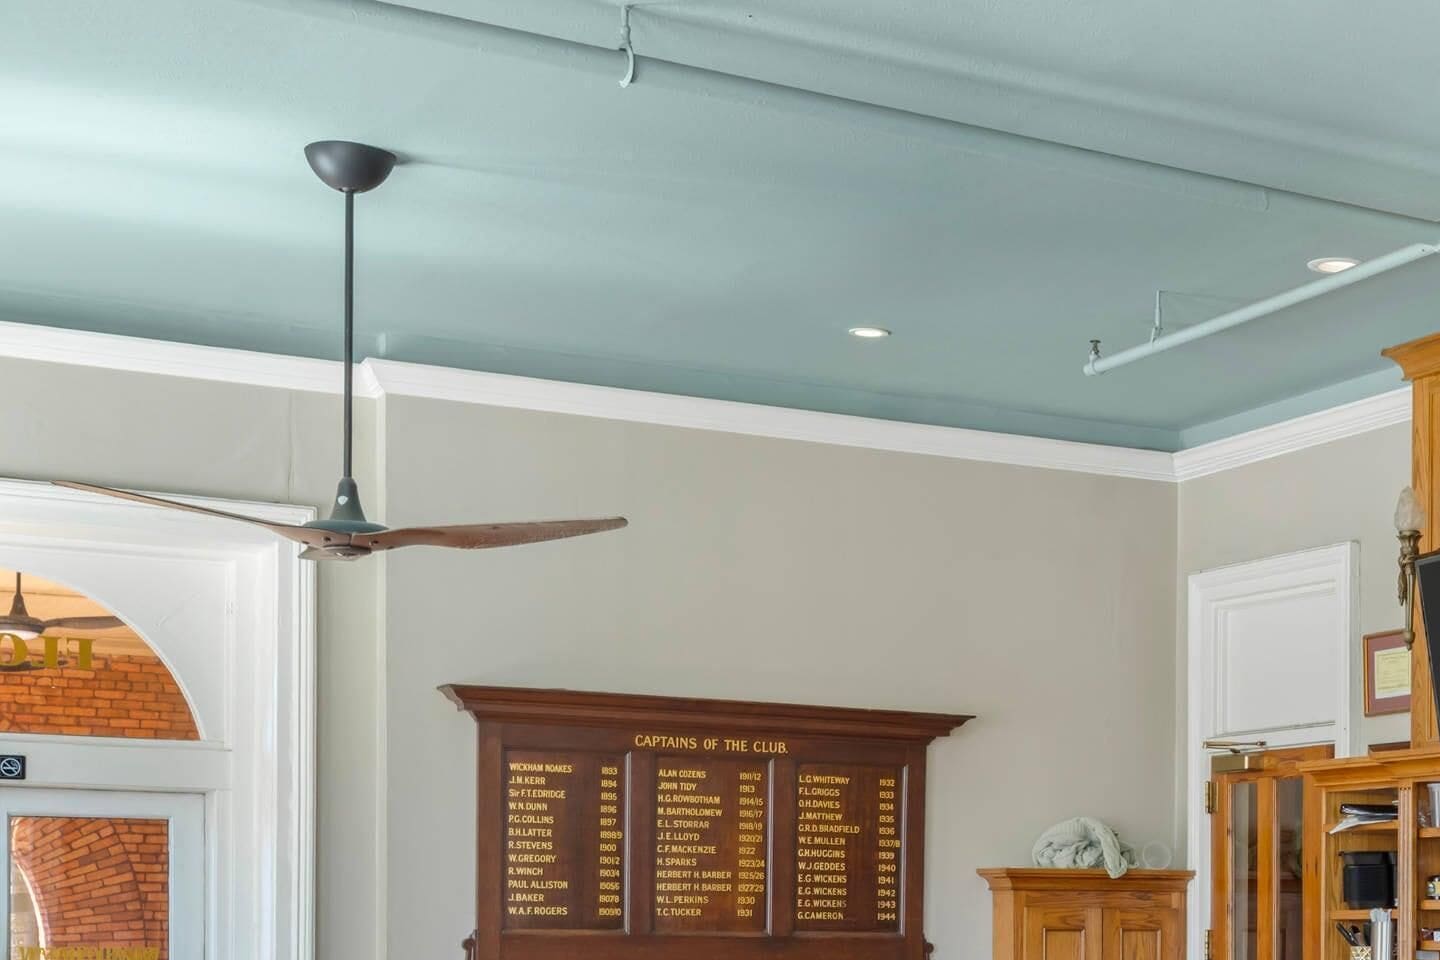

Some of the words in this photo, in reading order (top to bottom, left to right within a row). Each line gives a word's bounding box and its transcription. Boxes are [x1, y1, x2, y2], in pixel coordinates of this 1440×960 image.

[634, 735, 698, 749] CAPTAINS
[703, 738, 719, 750] OF
[723, 739, 748, 752] THE
[508, 762, 544, 772] WICKHAM
[544, 763, 573, 774] NOAKES
[658, 768, 678, 778] ALAN
[678, 769, 707, 779] COZENS
[657, 781, 678, 791] JOHN
[679, 782, 697, 791] TIDY
[508, 788, 521, 798] Sir
[656, 870, 692, 879] HERBERT
[701, 871, 732, 879] BARBER
[507, 879, 529, 889] PAUL
[530, 880, 568, 889] ALLISTON
[656, 882, 692, 892] HERBERT
[701, 883, 732, 892] BARBER
